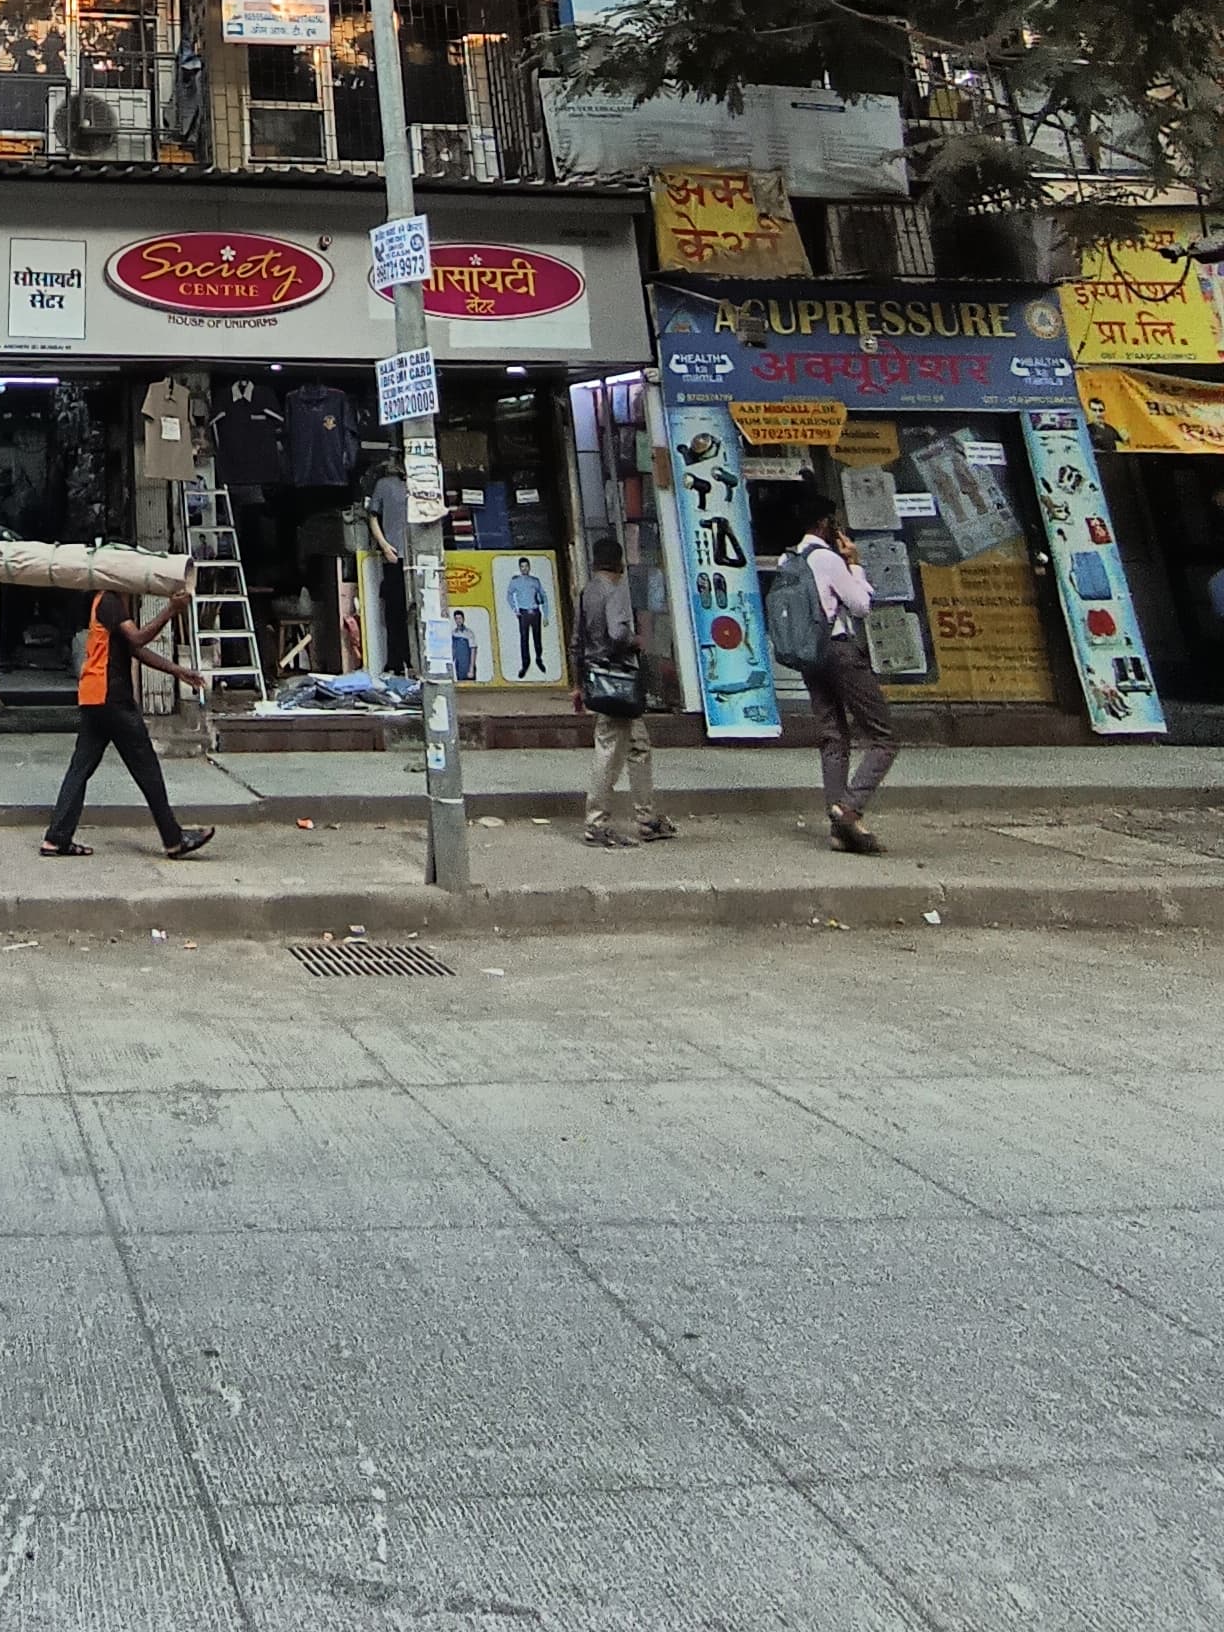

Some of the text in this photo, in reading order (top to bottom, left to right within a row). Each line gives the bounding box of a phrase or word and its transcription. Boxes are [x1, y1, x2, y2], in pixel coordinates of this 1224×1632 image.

[13, 266, 82, 289] सोसायटी
[140, 240, 303, 303] Society
[178, 282, 260, 298] CENTRE
[29, 288, 66, 310] सेंटर
[167, 315, 279, 330] HOUSE OF UNIFORMS
[714, 297, 1016, 338] ACUPRESSURE
[409, 350, 430, 366] CARD
[680, 353, 722, 364] HEALTH
[409, 364, 432, 380] CARD
